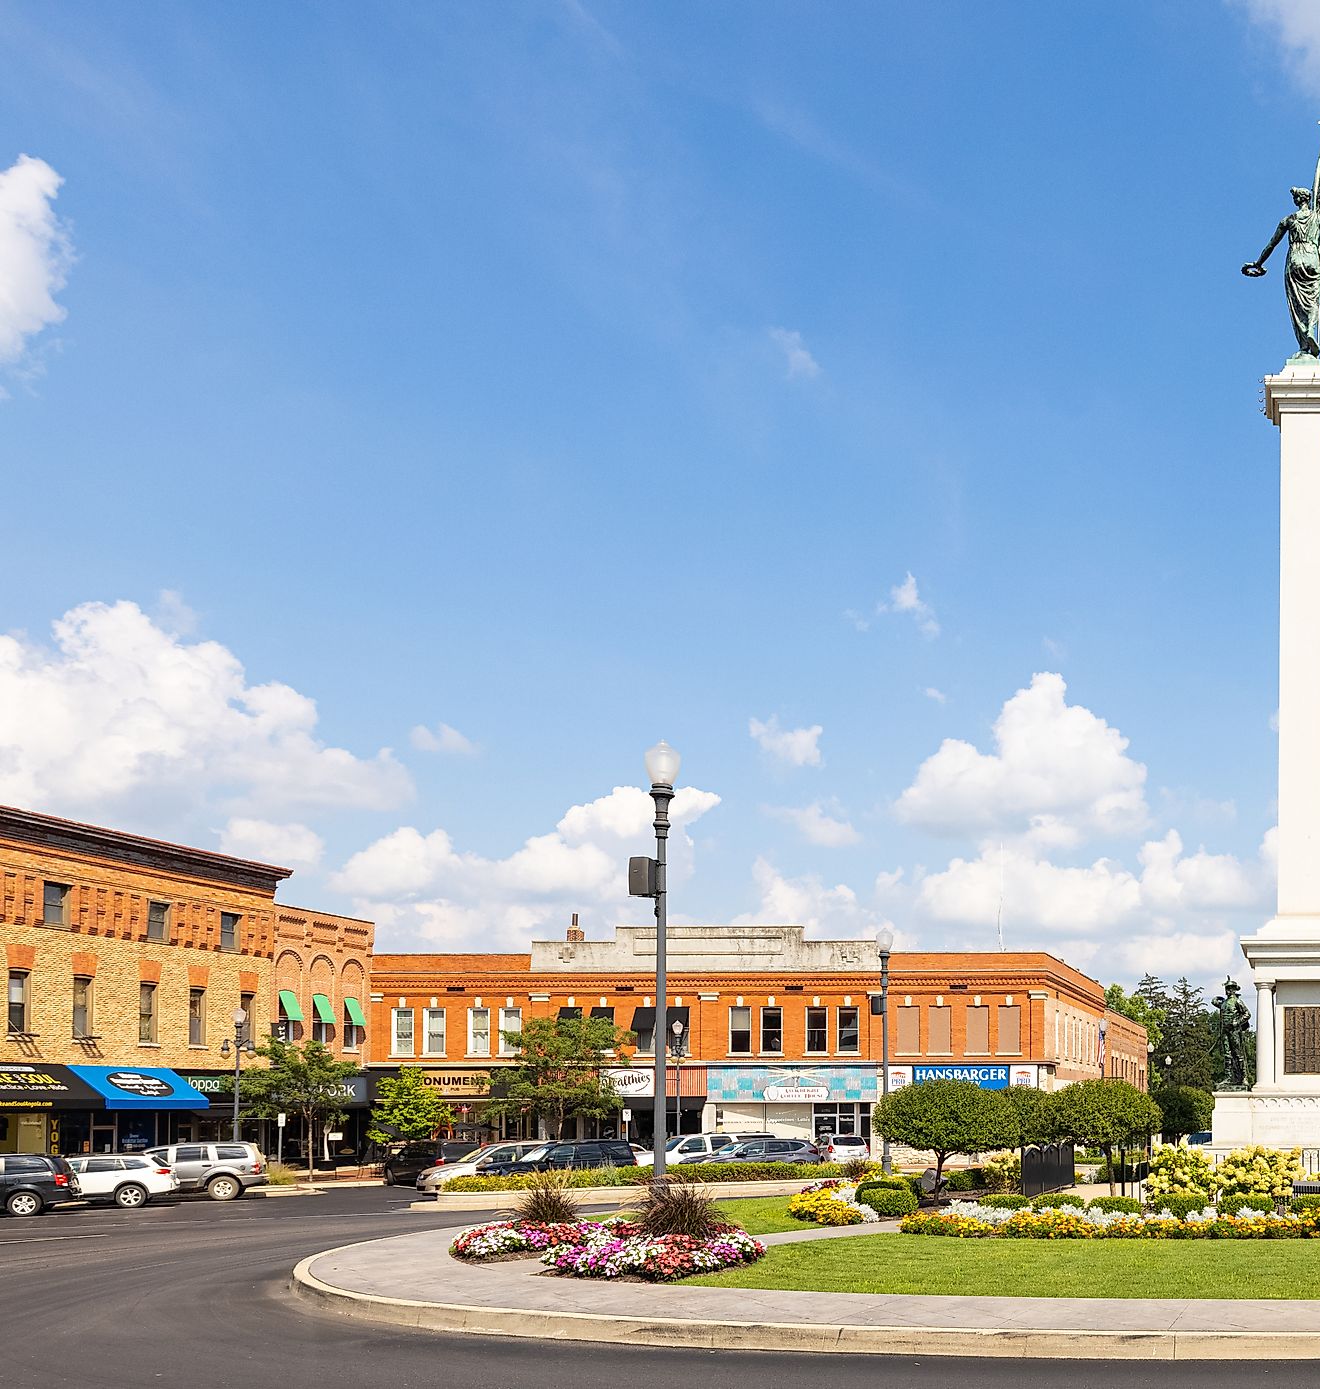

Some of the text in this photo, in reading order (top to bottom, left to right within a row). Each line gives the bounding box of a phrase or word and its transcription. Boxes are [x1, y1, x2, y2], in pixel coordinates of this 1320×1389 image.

[20, 1073, 62, 1084] SOUL
[915, 1069, 1006, 1081] HANSBARGER
[423, 1077, 487, 1086] ONUMENT
